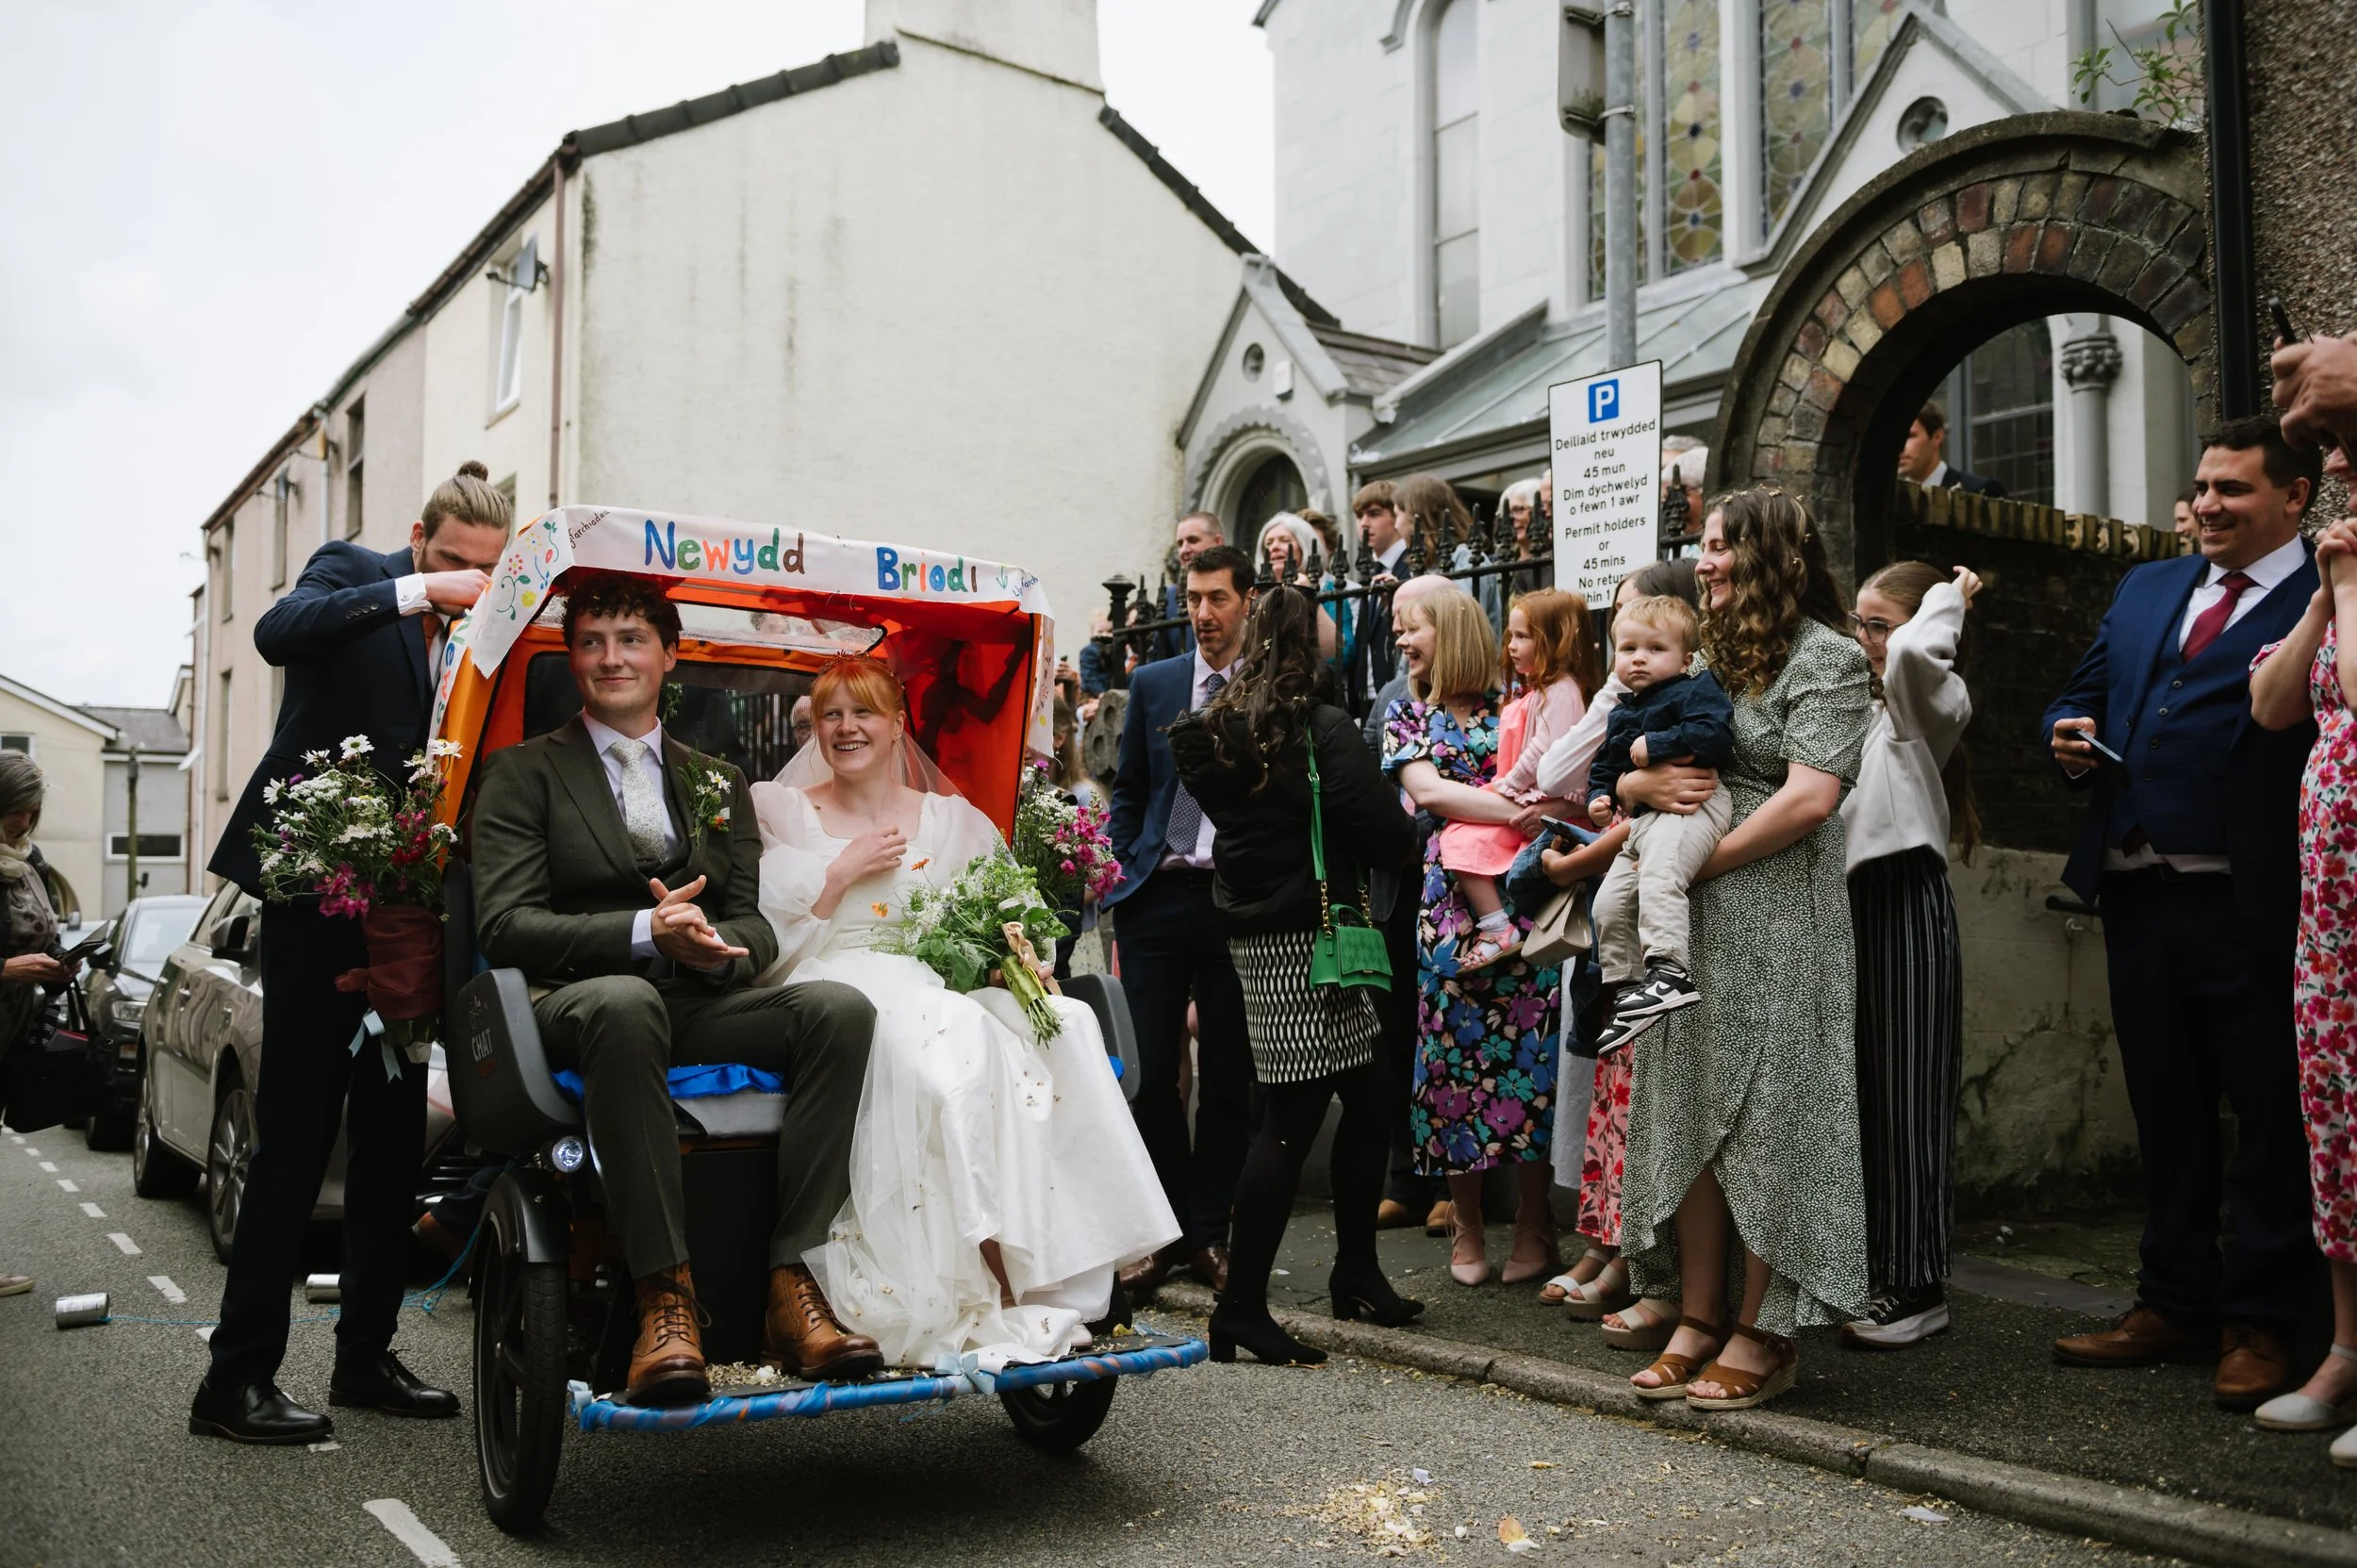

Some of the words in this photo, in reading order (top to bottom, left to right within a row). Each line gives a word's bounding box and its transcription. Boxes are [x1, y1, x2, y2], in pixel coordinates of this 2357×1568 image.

[1595, 385, 1614, 419] P
[1556, 432, 1596, 450] Deiliaid
[1601, 419, 1656, 441] trwydded
[1594, 448, 1614, 460] neu
[1584, 466, 1599, 479] 45
[1602, 463, 1625, 476] mun
[1564, 489, 1584, 501] Dim
[1589, 474, 1647, 497] dychwelyd
[1570, 506, 1575, 515] o
[1580, 501, 1607, 513] fewn
[1610, 496, 1615, 507] 1
[1620, 493, 1640, 506] awr
[1565, 522, 1600, 538] Permit
[1605, 517, 1645, 532] holders
[645, 520, 805, 574] Newydd
[876, 547, 978, 593] Briodi
[1599, 541, 1609, 551] or
[1584, 558, 1598, 569] 45
[1601, 555, 1625, 568] mins
[1578, 577, 1593, 588] No
[1597, 573, 1628, 585] retur
[1607, 590, 1610, 601] 1
[471, 1028, 492, 1062] CHAT
